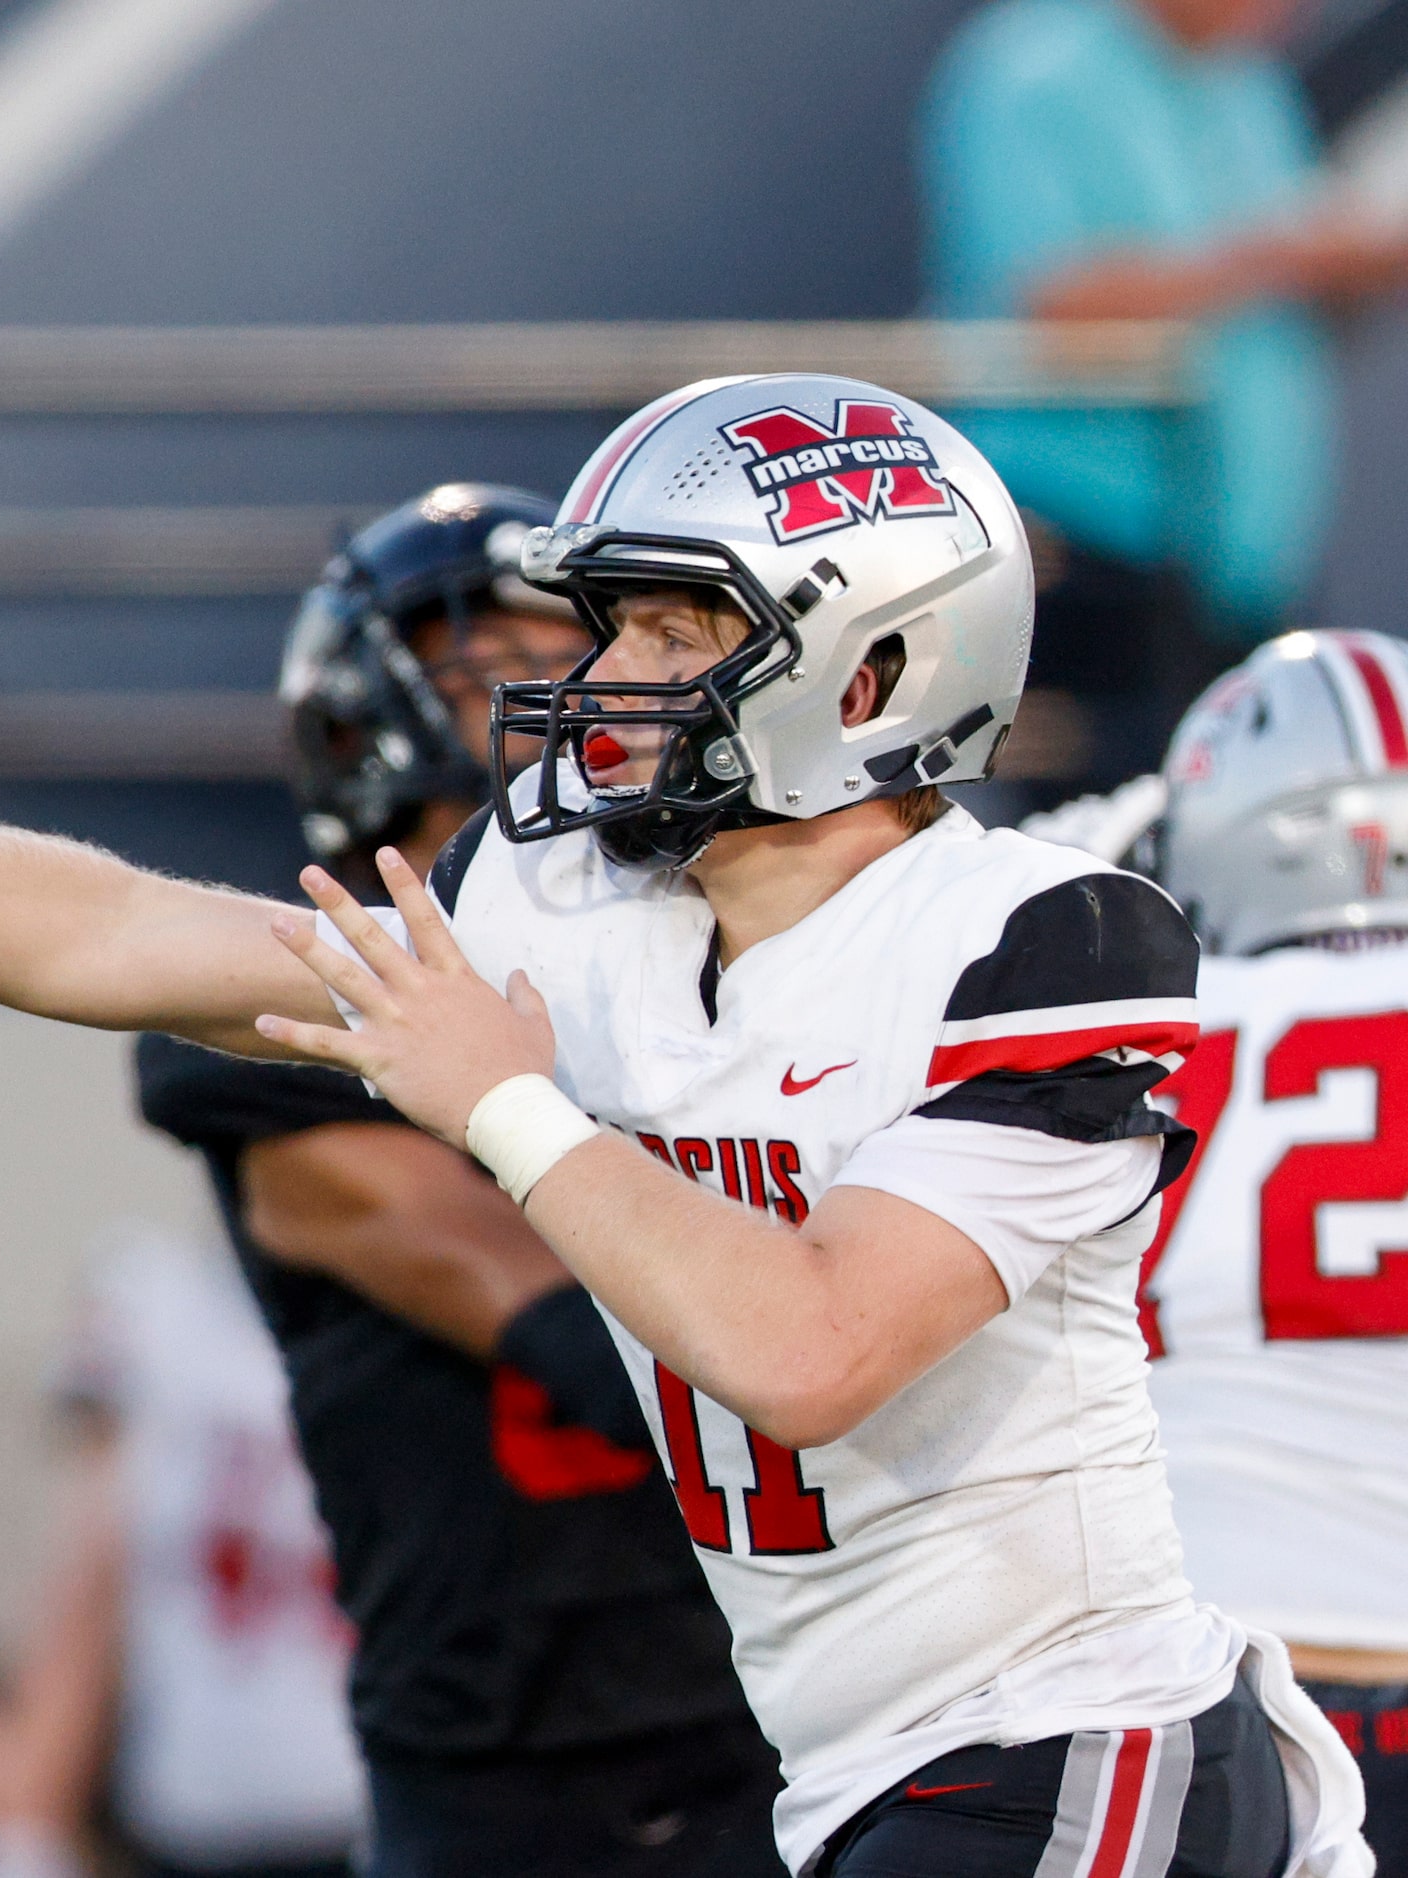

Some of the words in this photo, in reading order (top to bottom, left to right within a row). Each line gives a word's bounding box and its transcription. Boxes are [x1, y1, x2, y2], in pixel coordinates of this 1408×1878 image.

[717, 398, 958, 547] M
[751, 436, 930, 489] marcus
[1135, 1009, 1408, 1362] 72
